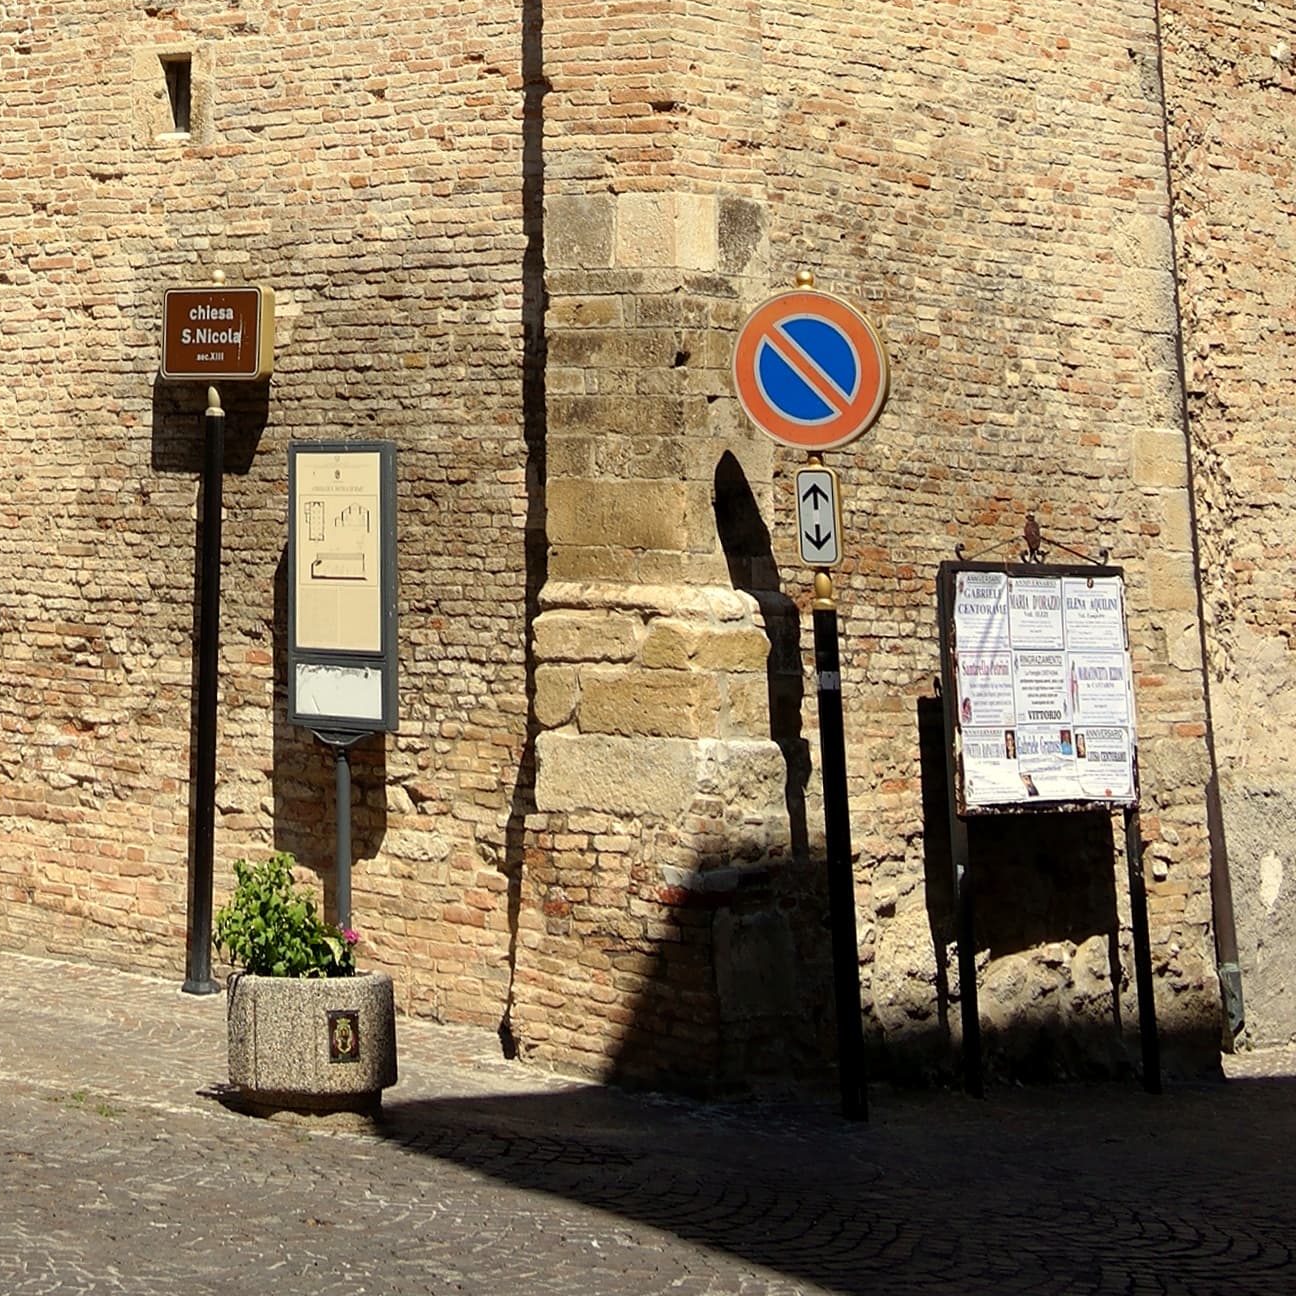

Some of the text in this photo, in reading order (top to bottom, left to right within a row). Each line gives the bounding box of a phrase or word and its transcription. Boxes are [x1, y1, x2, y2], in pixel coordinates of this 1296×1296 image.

[189, 305, 234, 320] chiesa
[181, 328, 241, 344] S.Nicola
[196, 352, 224, 361] sec.XIII
[1028, 710, 1062, 720] VITTORIO
